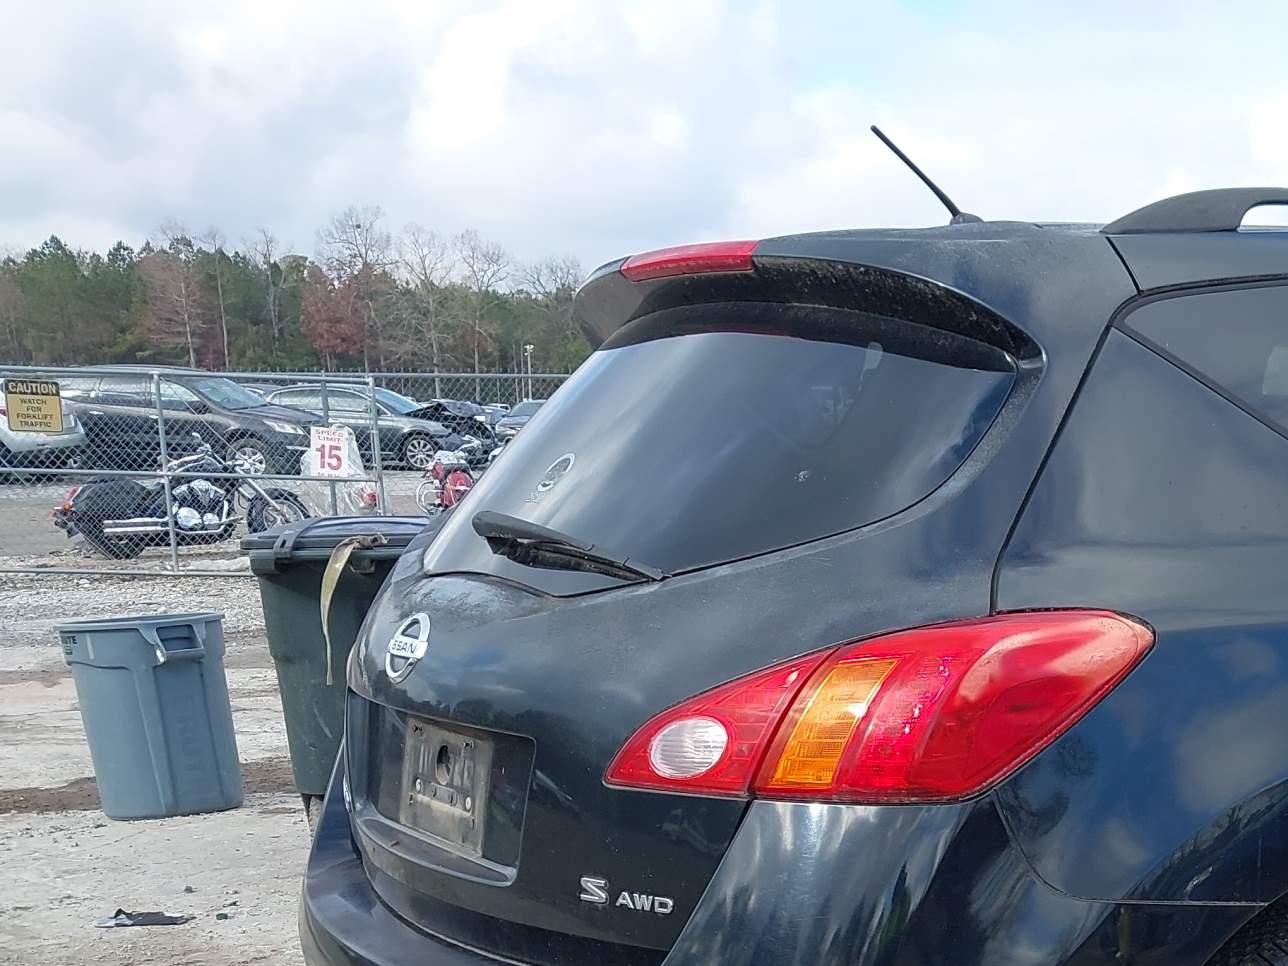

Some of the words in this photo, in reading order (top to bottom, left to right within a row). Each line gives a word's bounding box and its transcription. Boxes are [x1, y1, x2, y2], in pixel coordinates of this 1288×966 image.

[8, 382, 57, 394] CAUTION
[16, 412, 53, 421] FORKLIFT
[19, 420, 52, 428] TRAFFIC
[315, 429, 344, 438] SPEED
[318, 435, 342, 444] LIMIT
[315, 443, 343, 471] 15
[580, 876, 609, 904] S
[615, 891, 673, 914] AWD
